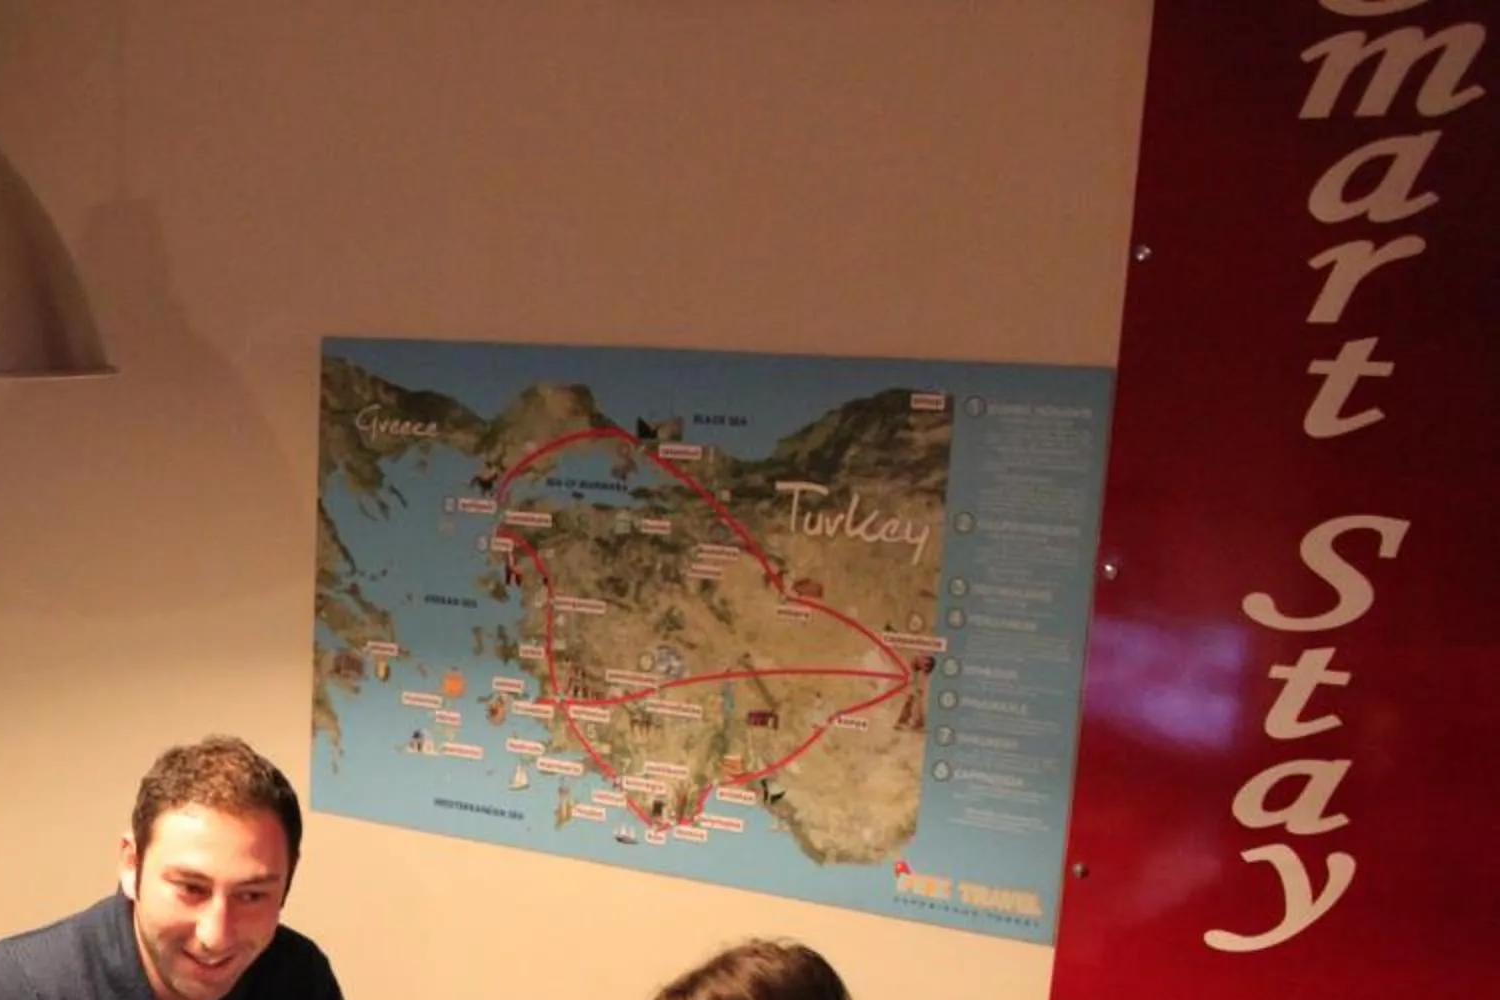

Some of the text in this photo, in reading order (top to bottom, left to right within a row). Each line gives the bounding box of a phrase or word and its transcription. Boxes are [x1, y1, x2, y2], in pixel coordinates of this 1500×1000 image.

[1298, 0, 1487, 438] mart
[355, 403, 439, 440] Greece
[775, 481, 930, 566] Turkey
[1202, 514, 1411, 953] Stay
